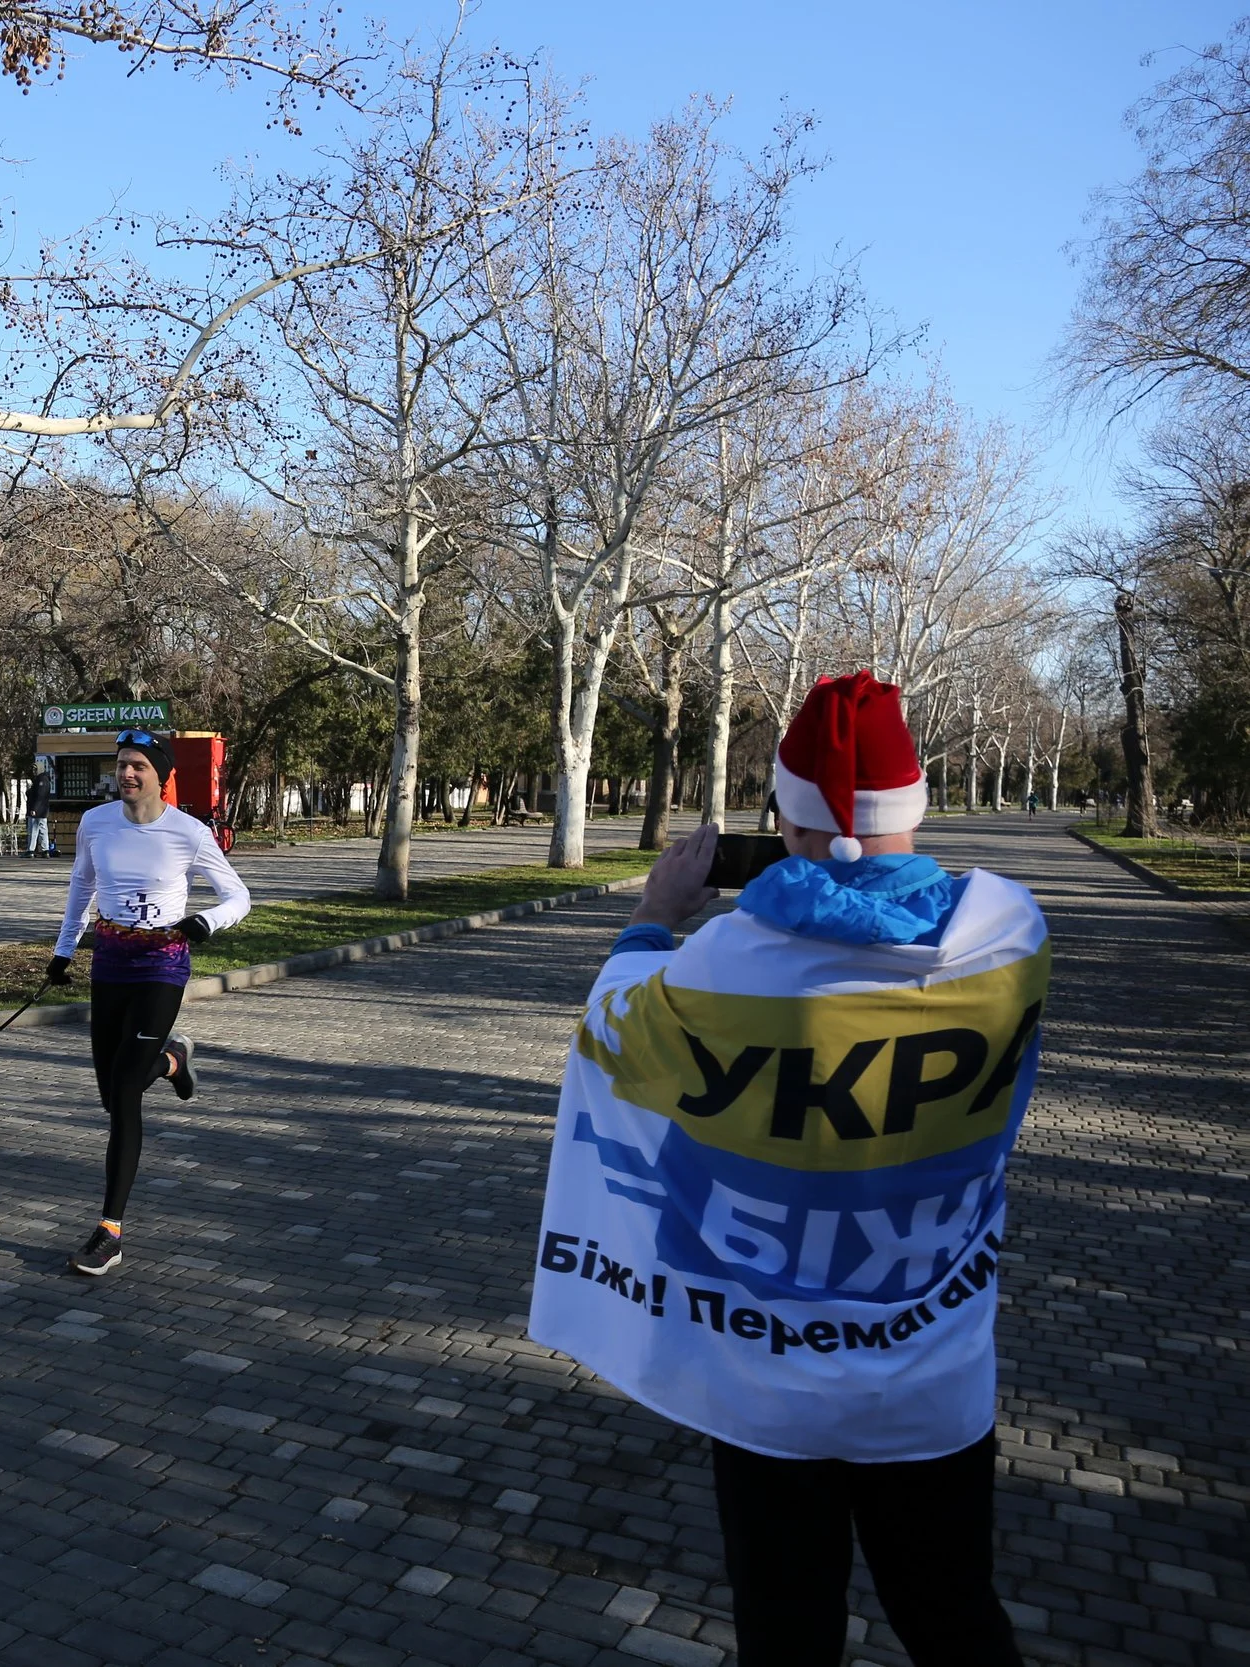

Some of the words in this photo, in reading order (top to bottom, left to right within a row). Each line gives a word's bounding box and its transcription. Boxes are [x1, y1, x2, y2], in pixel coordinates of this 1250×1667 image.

[66, 707, 116, 722] GREEN
[119, 705, 165, 720] KAVA
[699, 1152, 1007, 1294] БІЖ
